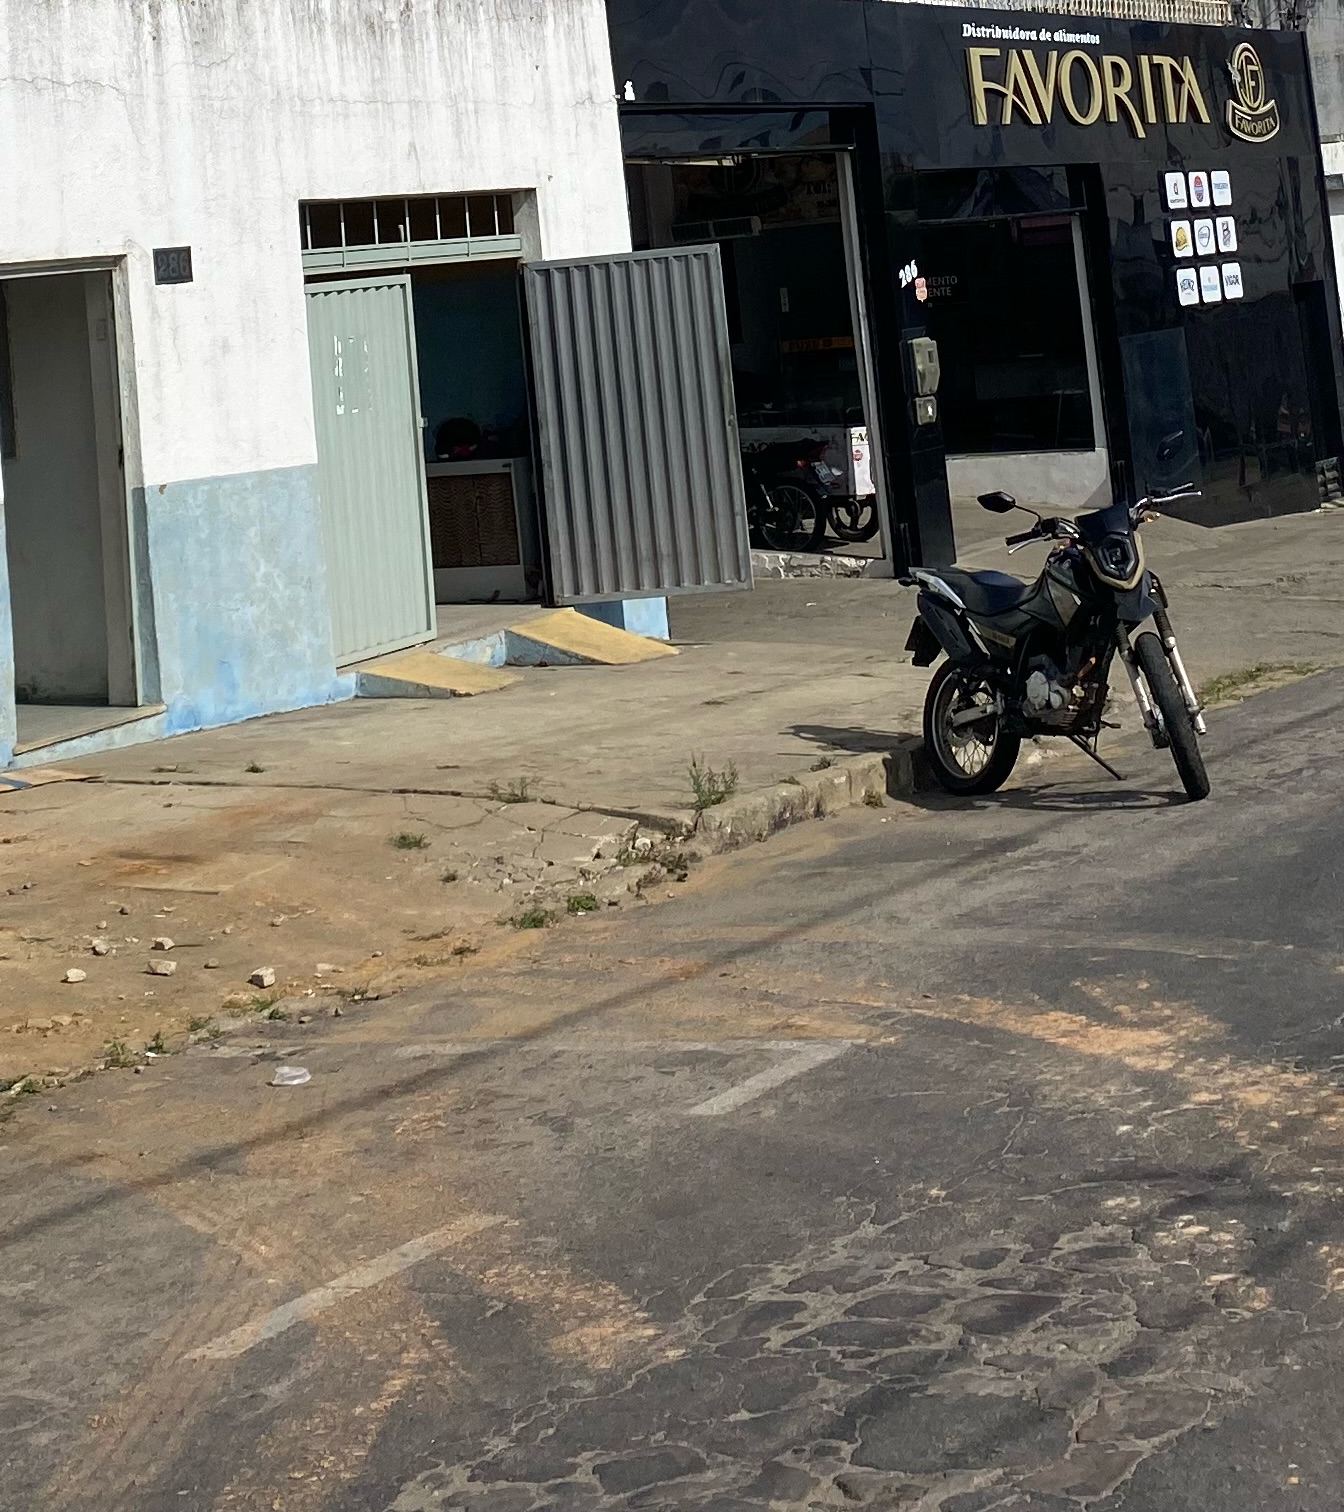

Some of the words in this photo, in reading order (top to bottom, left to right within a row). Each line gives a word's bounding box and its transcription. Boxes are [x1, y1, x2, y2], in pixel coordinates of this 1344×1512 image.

[962, 23, 1037, 42] Distribuidora
[1039, 28, 1051, 42] de
[1053, 29, 1100, 45] alimentos
[965, 47, 1210, 138] FAVORITA
[1235, 114, 1276, 135] FAVORITA
[157, 252, 191, 279] 286
[899, 259, 918, 288] 286
